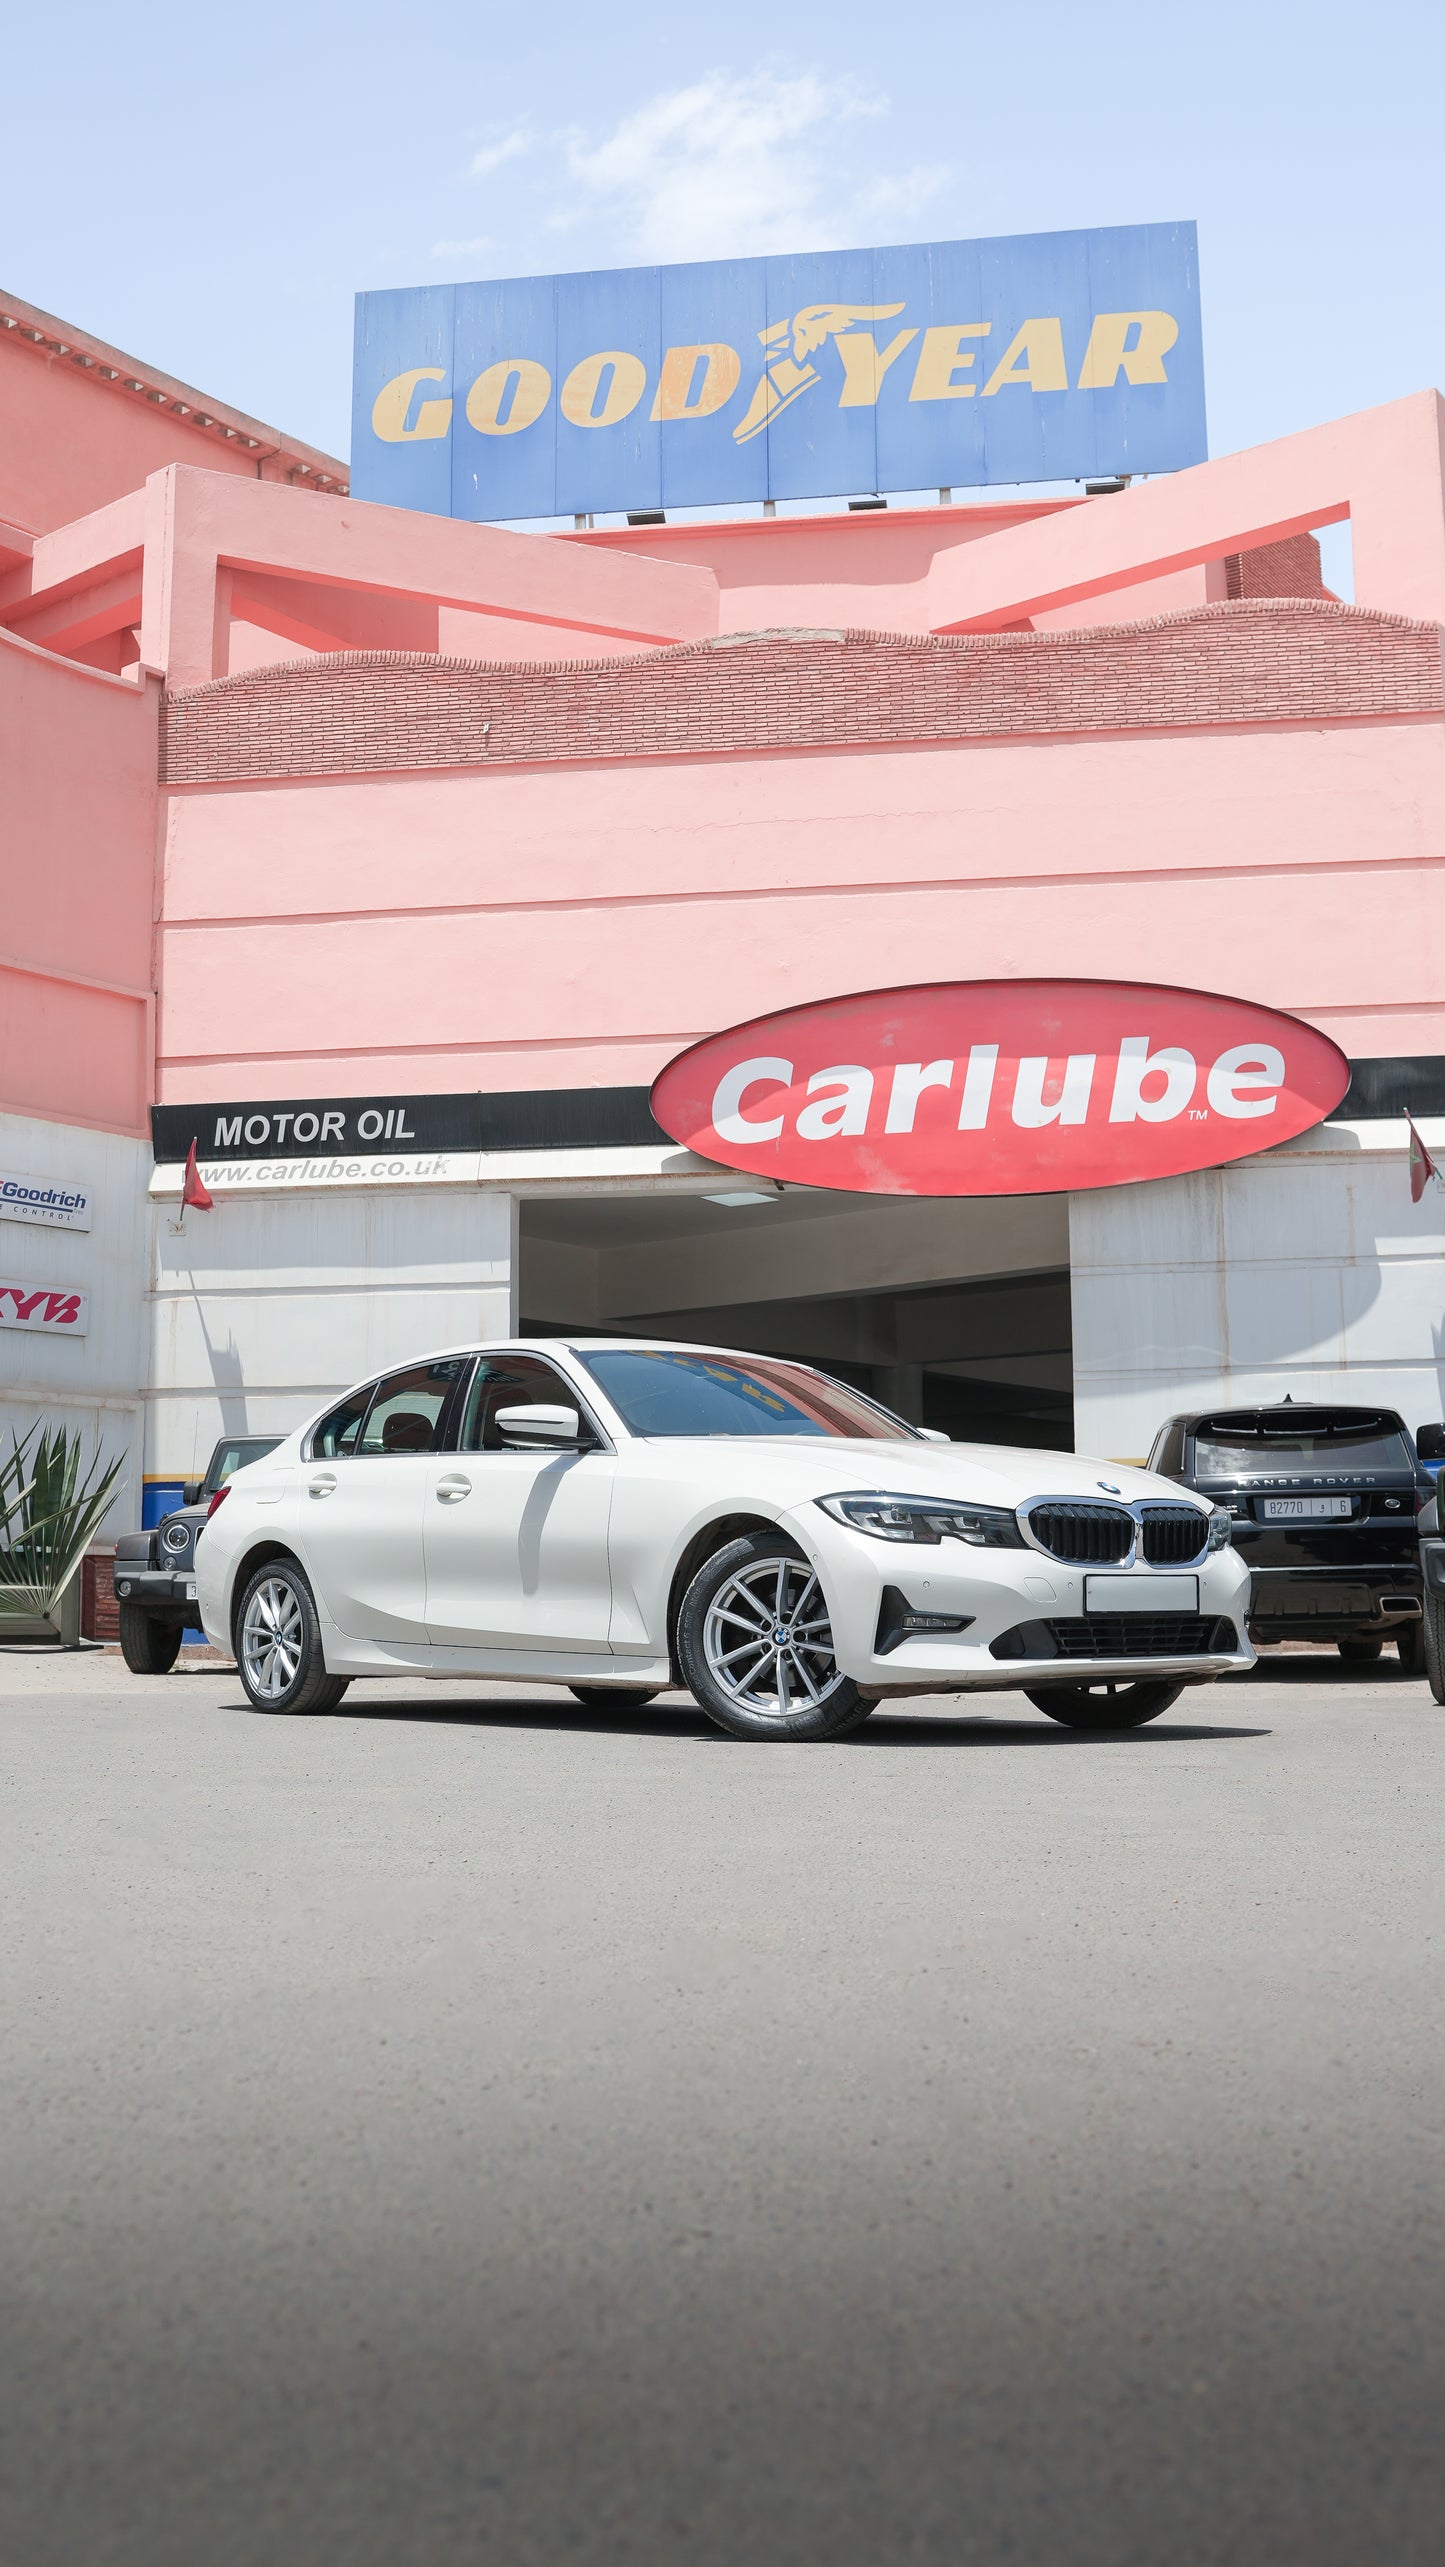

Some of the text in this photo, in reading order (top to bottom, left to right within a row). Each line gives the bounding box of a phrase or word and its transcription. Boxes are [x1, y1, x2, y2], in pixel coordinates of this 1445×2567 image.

[711, 1036, 1288, 1145] Carlube
[214, 1109, 416, 1147] MOTOR OIL
[13, 1206, 71, 1221] CONTROL
[1237, 1477, 1376, 1487] RANGE ROVER
[1270, 1501, 1303, 1514] 82770
[1340, 1500, 1347, 1513] 6
